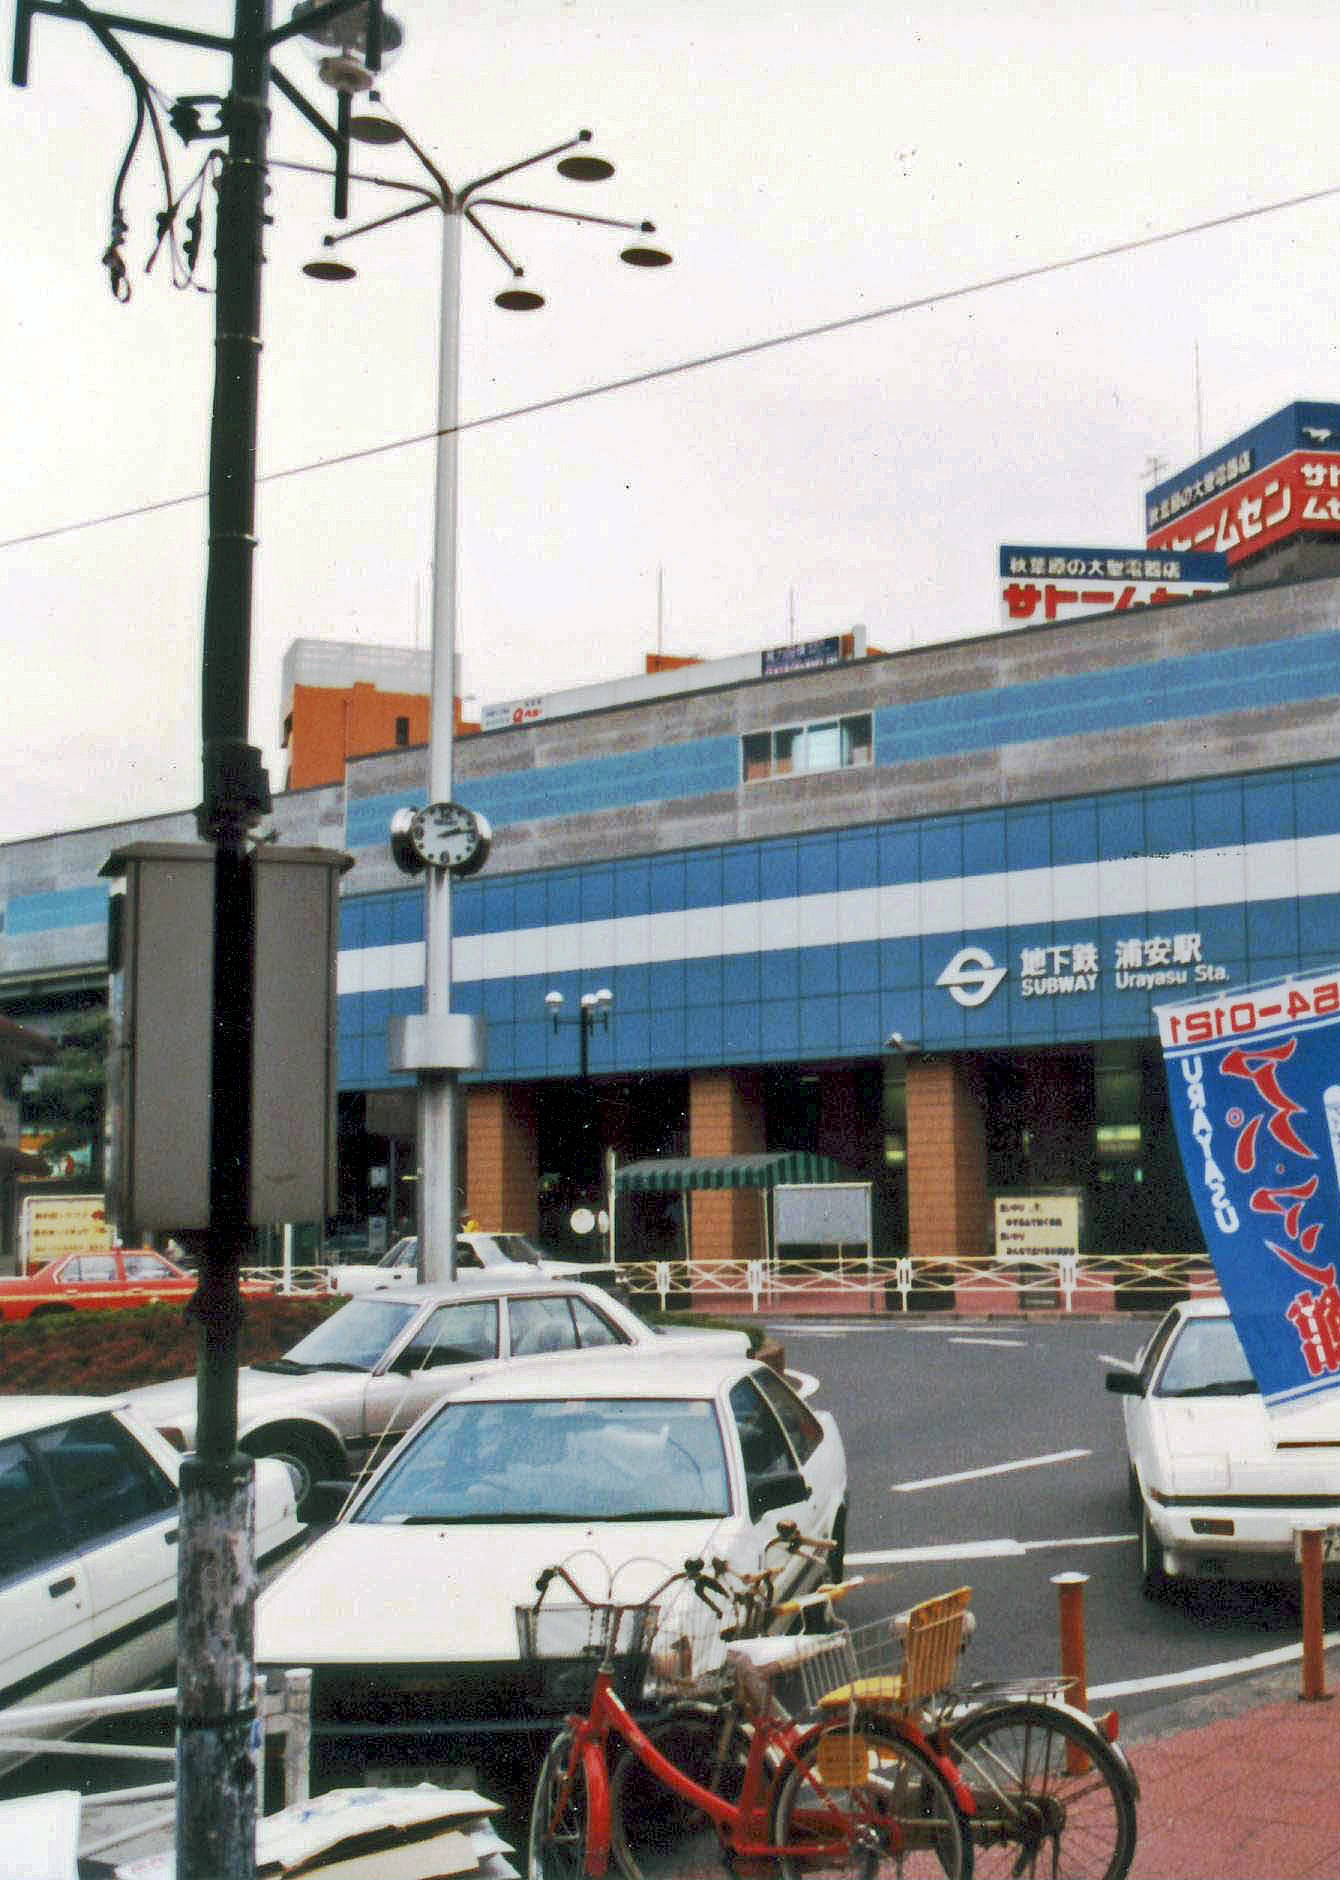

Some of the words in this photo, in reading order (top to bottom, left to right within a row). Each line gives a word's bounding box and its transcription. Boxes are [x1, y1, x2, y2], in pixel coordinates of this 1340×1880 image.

[1020, 942, 1099, 977] 地下鉄
[1115, 933, 1203, 970] 浦安駅
[1021, 974, 1098, 998] SUBWAY
[1115, 968, 1188, 991] Urayasu
[1194, 963, 1231, 983] Sta.
